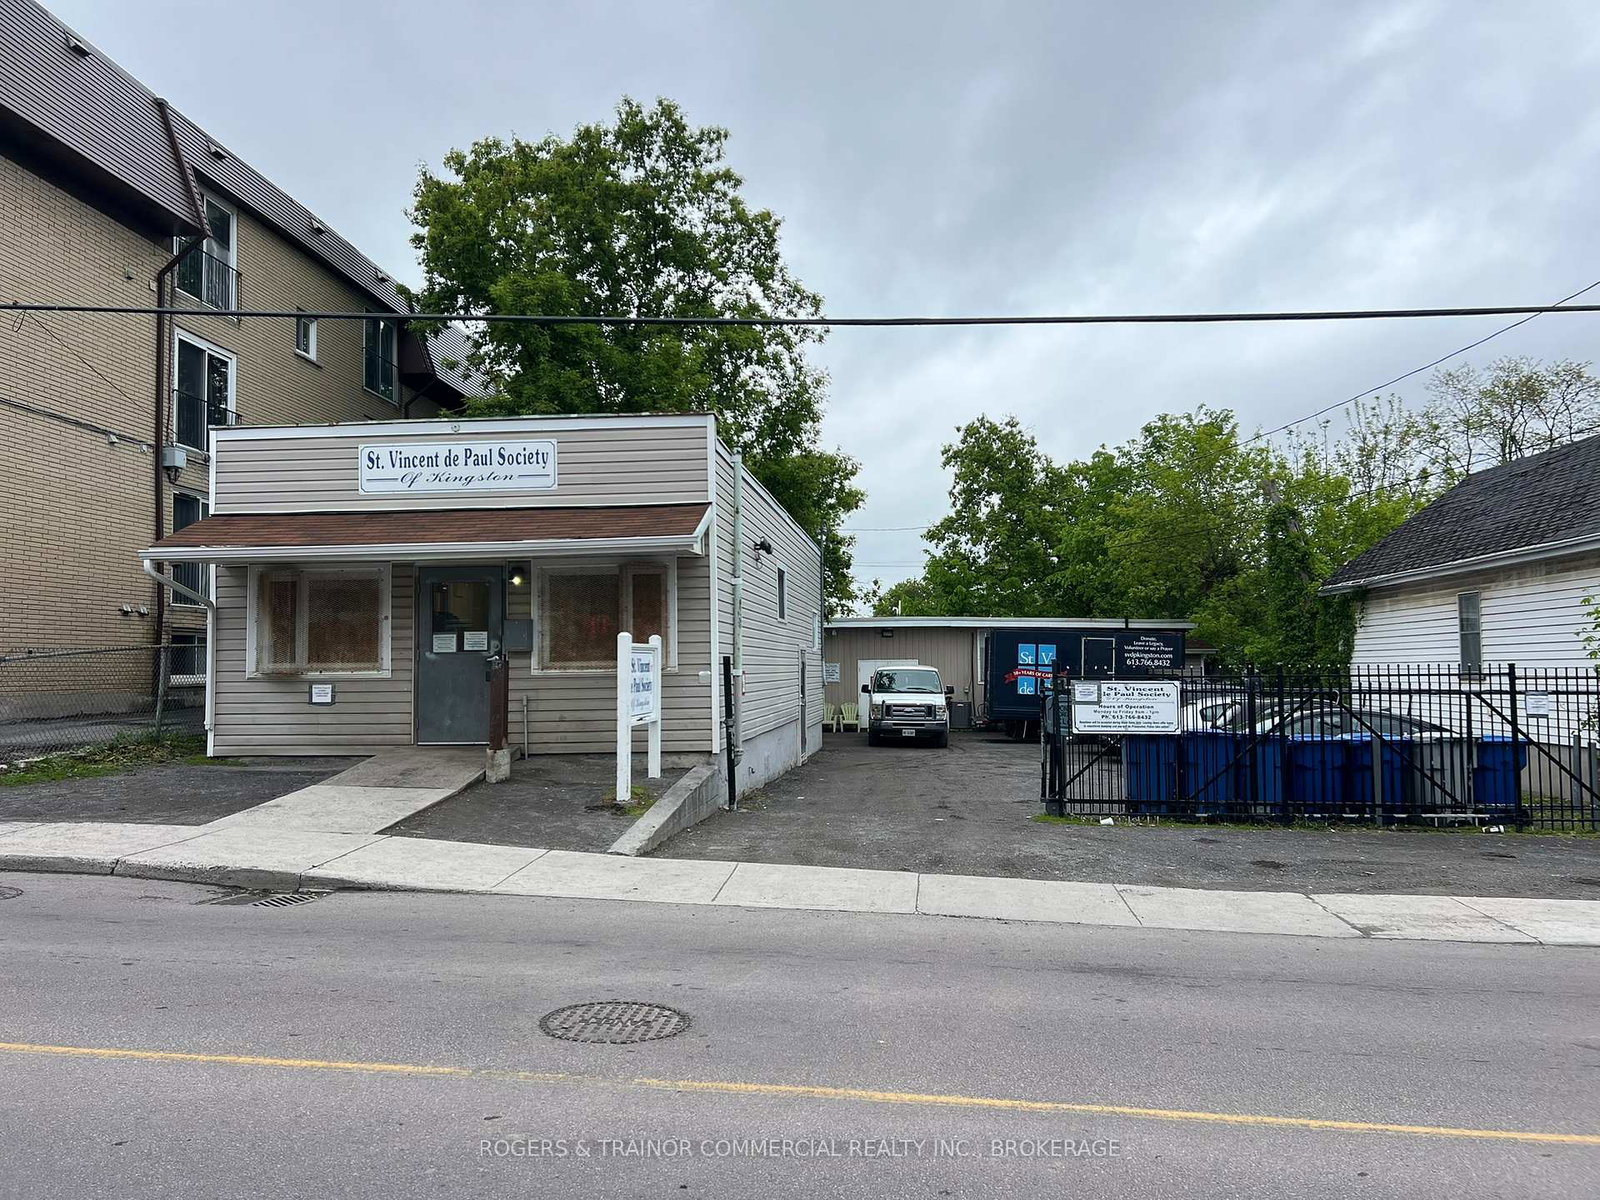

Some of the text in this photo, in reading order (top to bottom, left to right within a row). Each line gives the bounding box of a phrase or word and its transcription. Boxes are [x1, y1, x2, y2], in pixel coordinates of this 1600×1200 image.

[366, 446, 549, 470] St. Vincent de Paul Society
[400, 471, 514, 488] Of Kingston
[1019, 651, 1053, 664] St V
[1019, 682, 1034, 694] de
